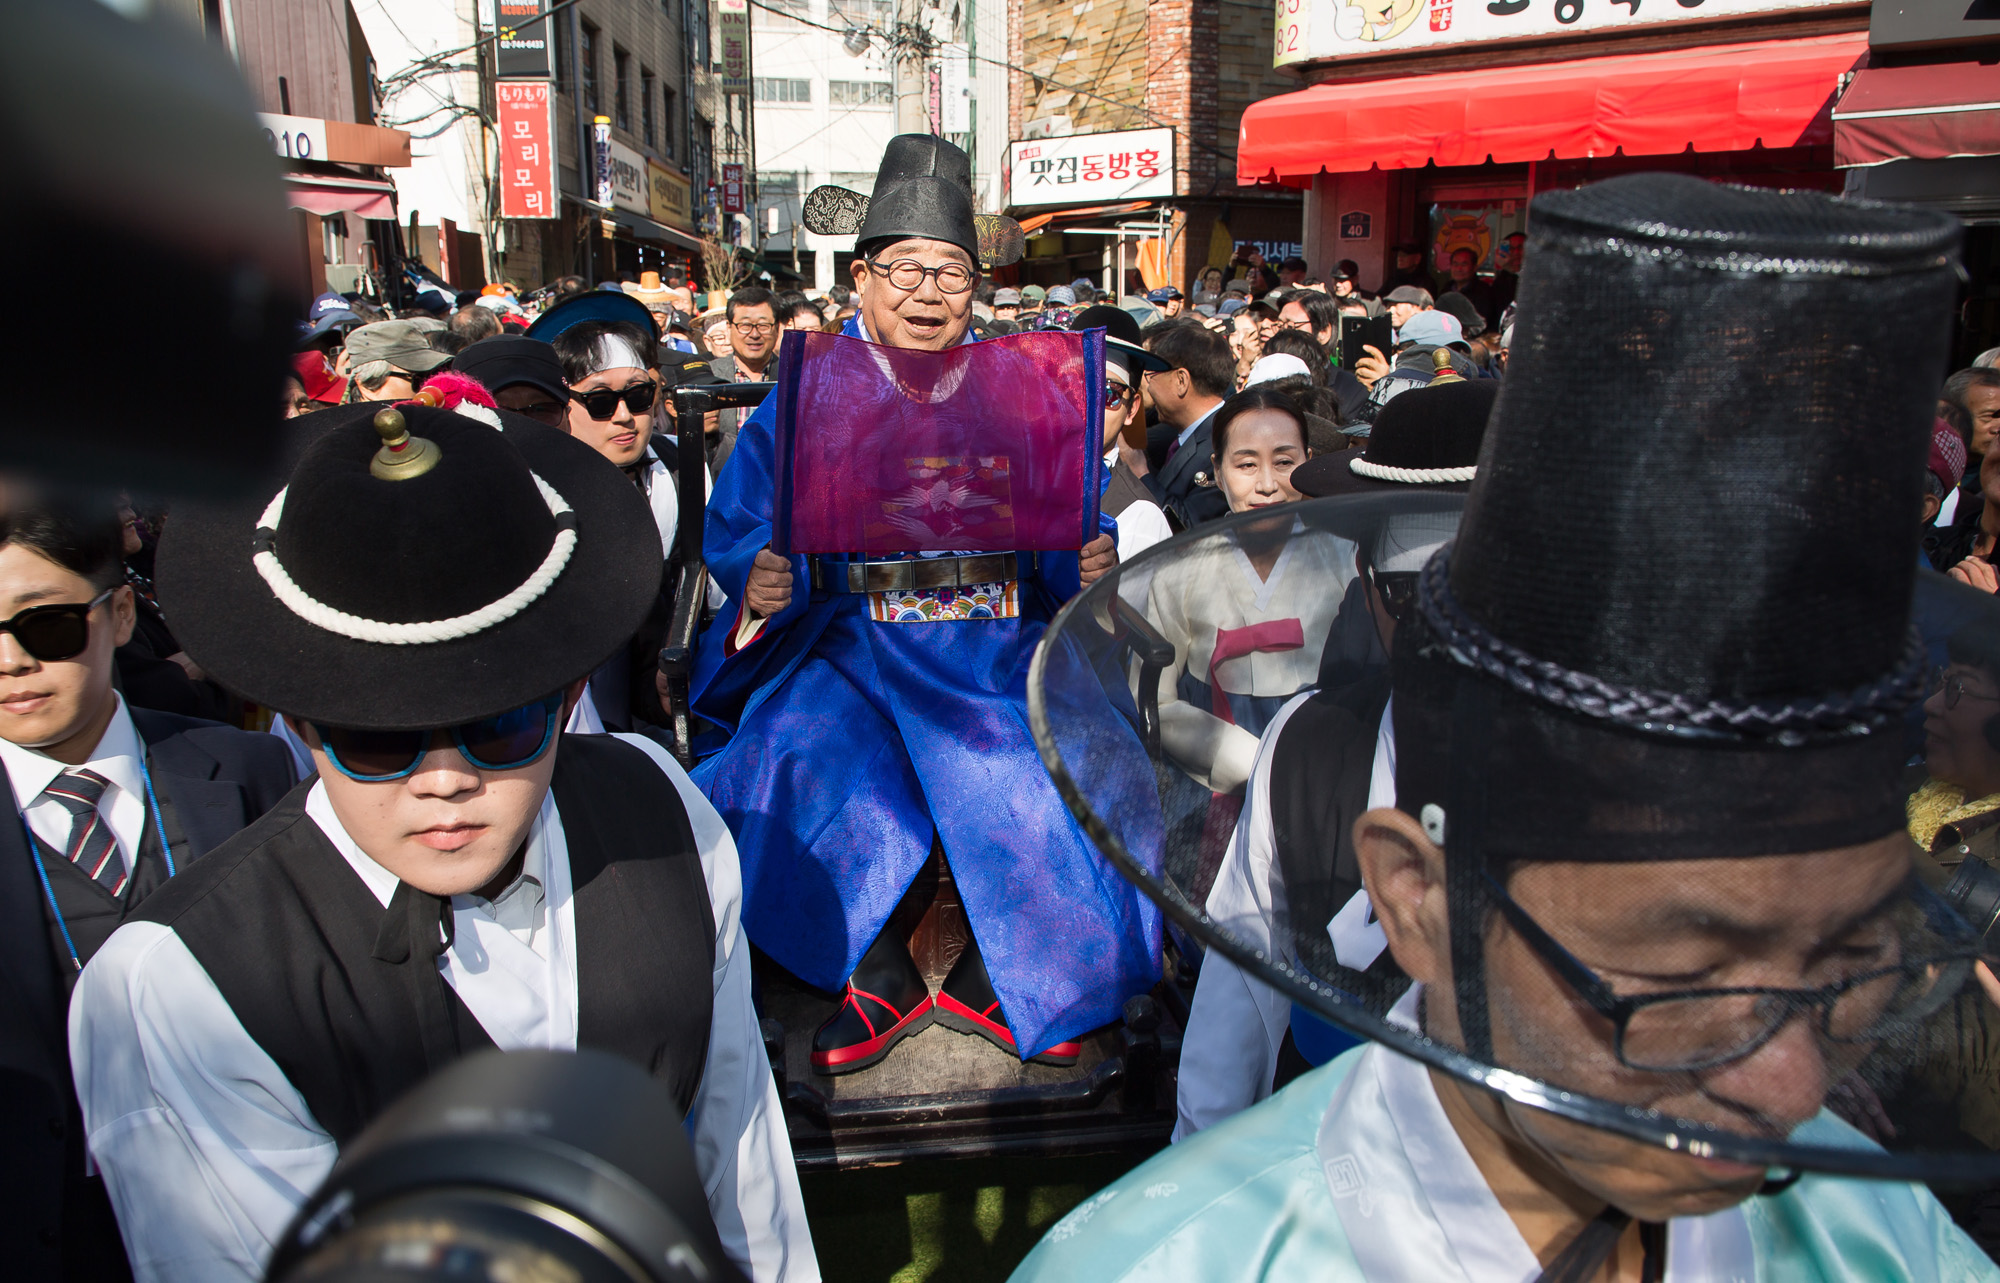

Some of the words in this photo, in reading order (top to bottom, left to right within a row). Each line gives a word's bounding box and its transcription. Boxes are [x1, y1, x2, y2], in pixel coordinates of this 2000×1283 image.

[1277, 24, 1298, 56] 82
[501, 87, 546, 102] もりもり
[1348, 224, 1363, 236] 40
